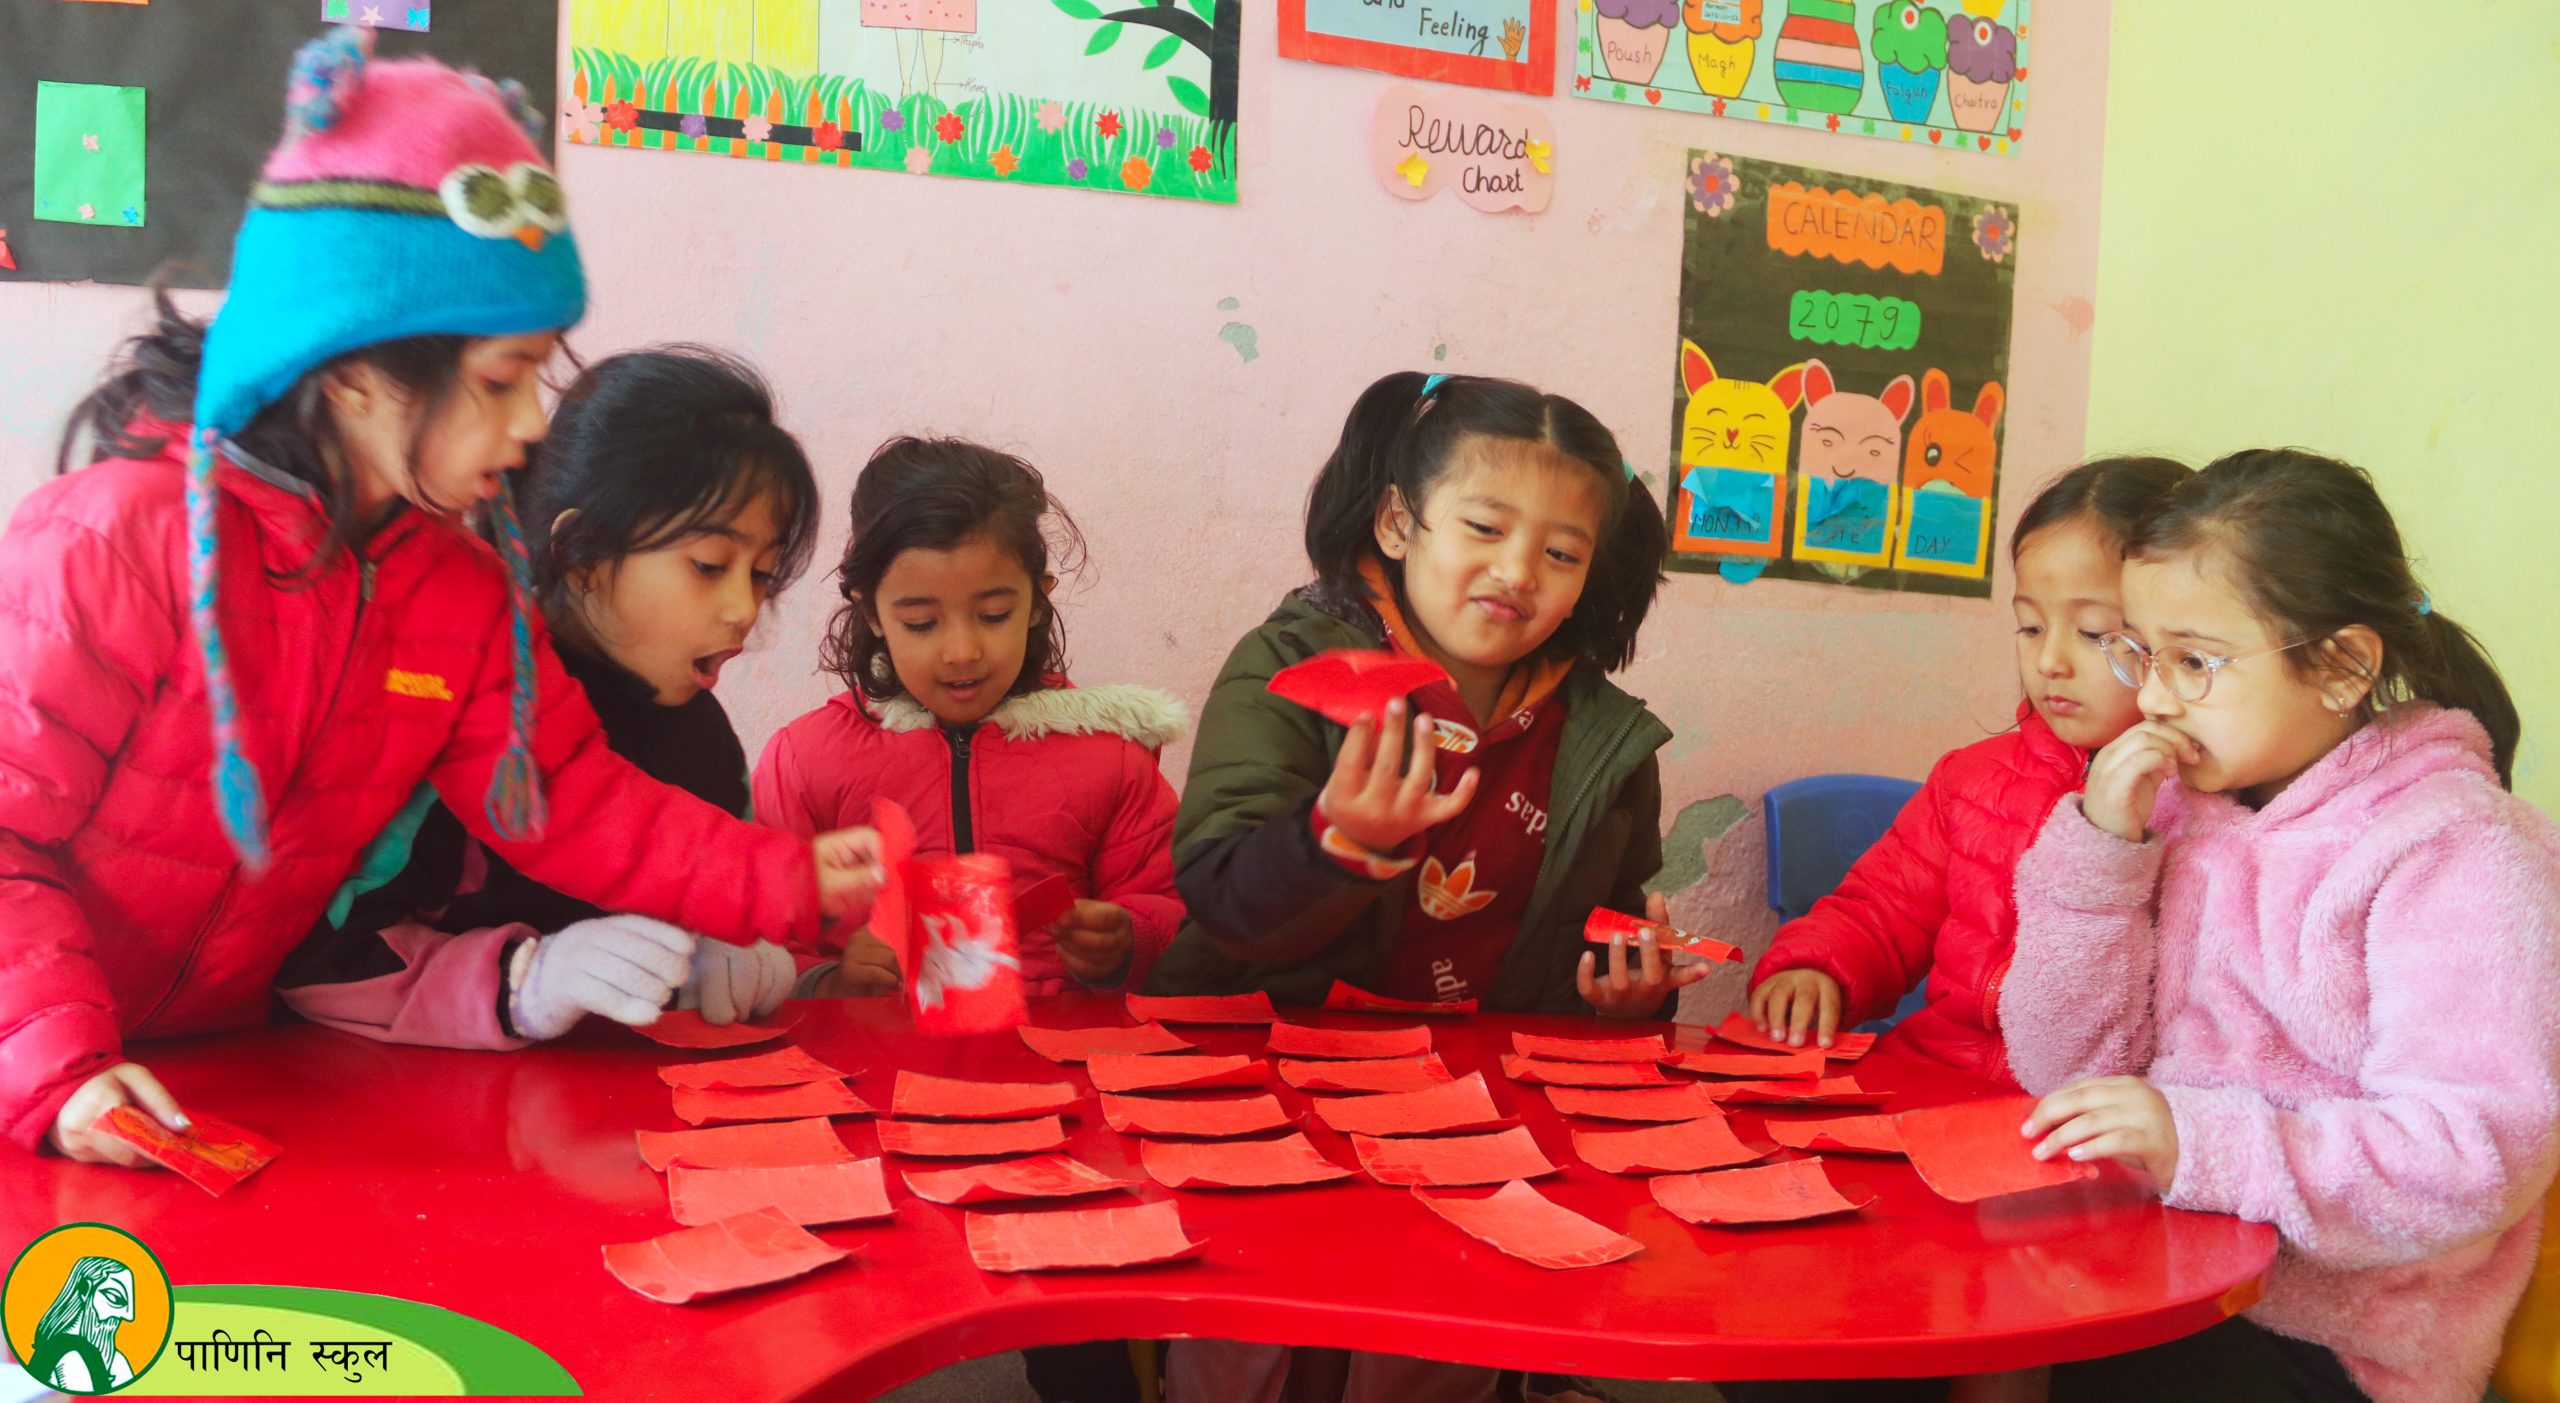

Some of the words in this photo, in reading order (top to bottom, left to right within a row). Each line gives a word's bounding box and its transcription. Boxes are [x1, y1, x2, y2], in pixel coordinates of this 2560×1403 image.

[1419, 7, 1489, 57] Feeling
[1607, 41, 1652, 64] Poush
[1698, 53, 1736, 78] Magh
[1886, 81, 1928, 105] Falgun
[1954, 93, 1998, 109] Chaitra
[1398, 104, 1530, 160] Reward
[1462, 165, 1524, 193] Chart
[1783, 201, 1937, 252] CALENDAR
[1798, 299, 1900, 345] 2079
[1914, 534, 1952, 555] DAY
